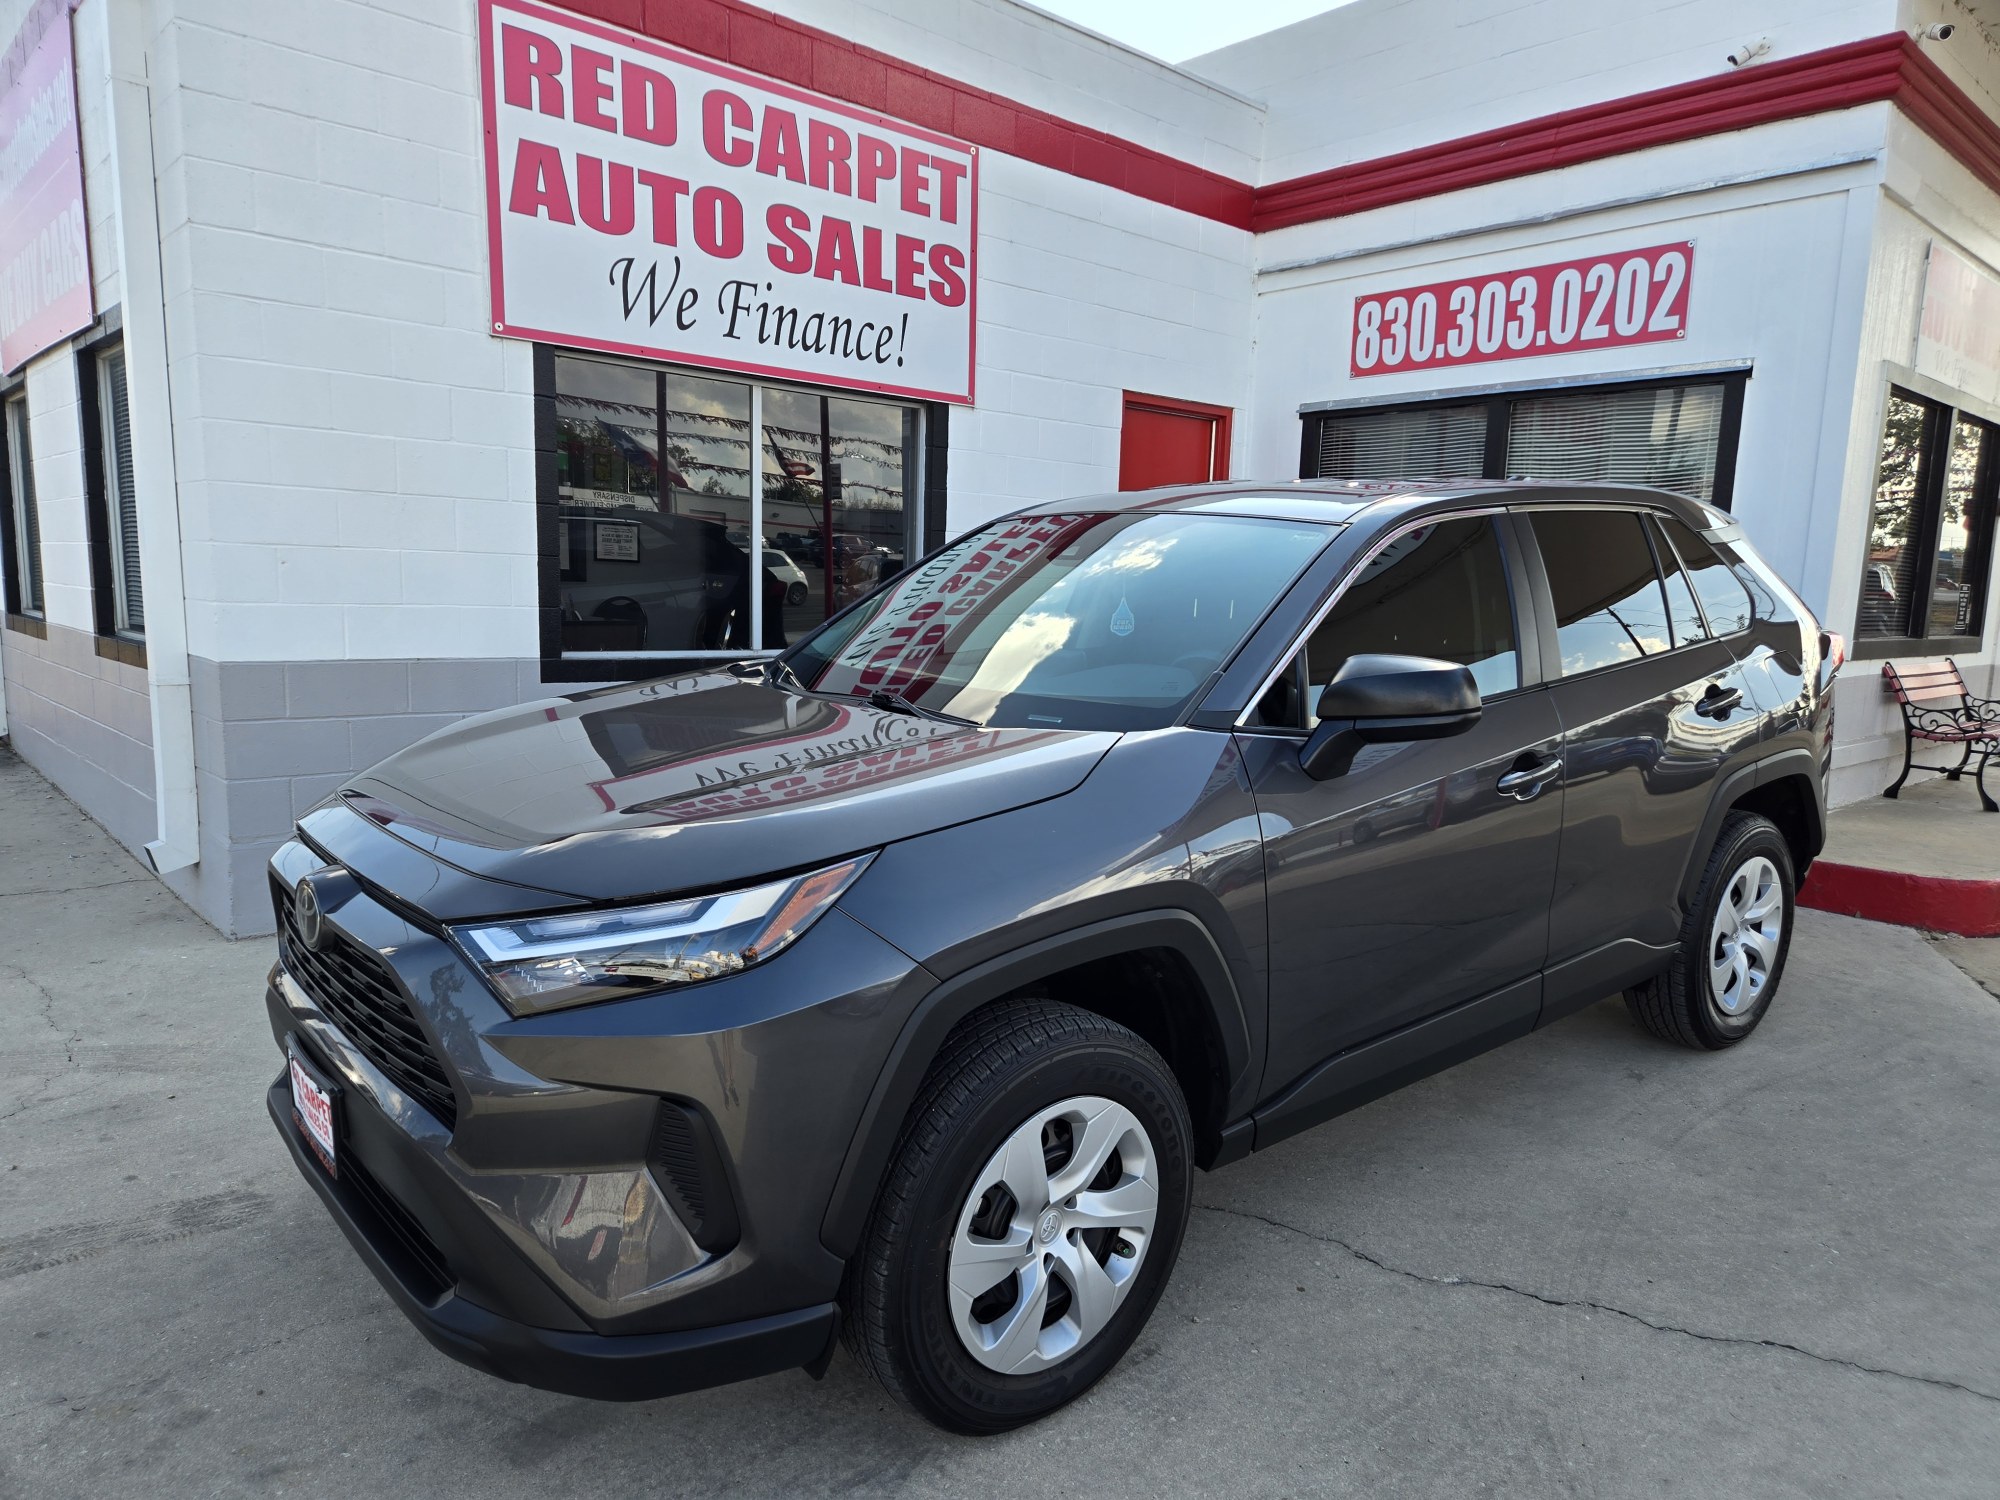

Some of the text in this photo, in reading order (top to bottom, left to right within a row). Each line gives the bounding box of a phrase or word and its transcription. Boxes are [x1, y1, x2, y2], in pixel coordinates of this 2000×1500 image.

[501, 22, 967, 225] RED CARPET
[41, 198, 86, 307] CARS
[508, 137, 966, 308] AUTO SALES
[609, 255, 909, 368] We Finance!
[1355, 251, 1686, 369] 830.303.0202
